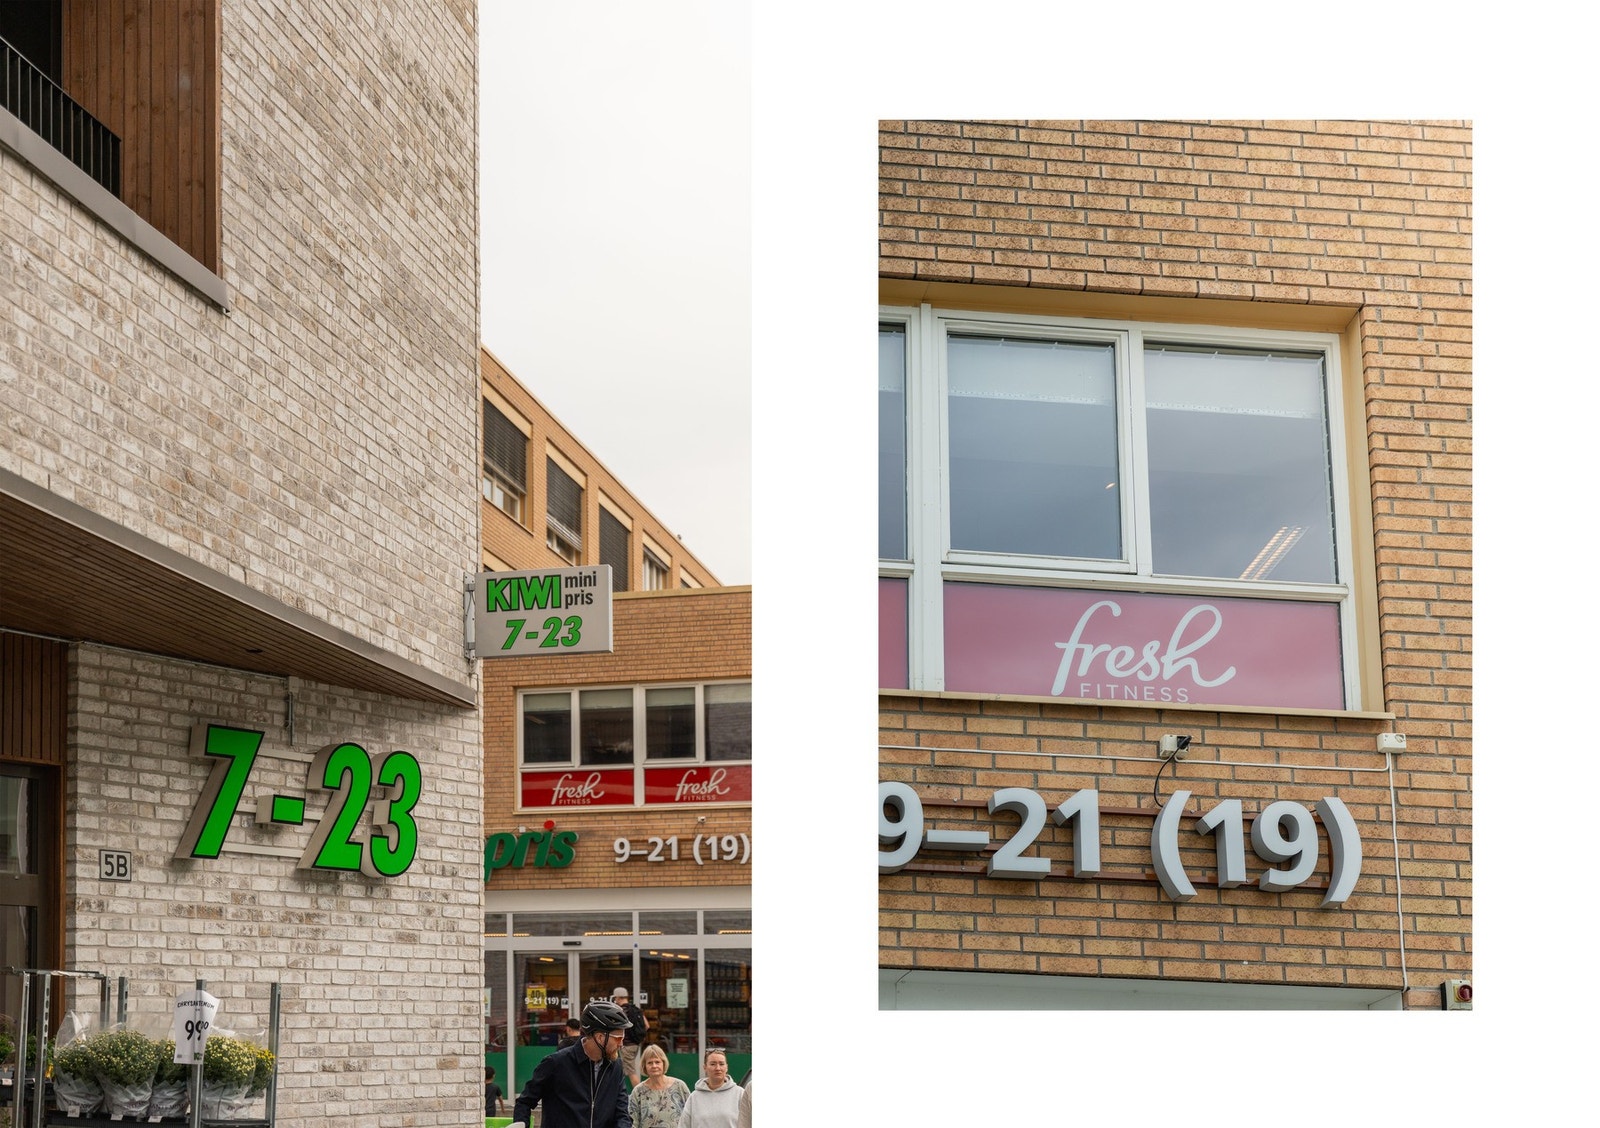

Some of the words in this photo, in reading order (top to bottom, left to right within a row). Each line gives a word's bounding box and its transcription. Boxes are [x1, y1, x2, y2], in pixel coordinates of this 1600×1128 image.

[486, 574, 562, 613] KIWI
[564, 570, 597, 589] mini
[564, 588, 594, 609] pris
[1051, 600, 1236, 697] fresh
[1080, 682, 1190, 704] FITNESS
[551, 771, 605, 805] fresh
[558, 797, 592, 806] FITNESS
[674, 768, 731, 802] fresh
[683, 793, 717, 802] FITNESS
[103, 853, 128, 878] 5B
[484, 819, 580, 883] pris
[692, 832, 751, 866] (19)
[1151, 789, 1363, 909] (19)
[544, 995, 559, 1006] (19)
